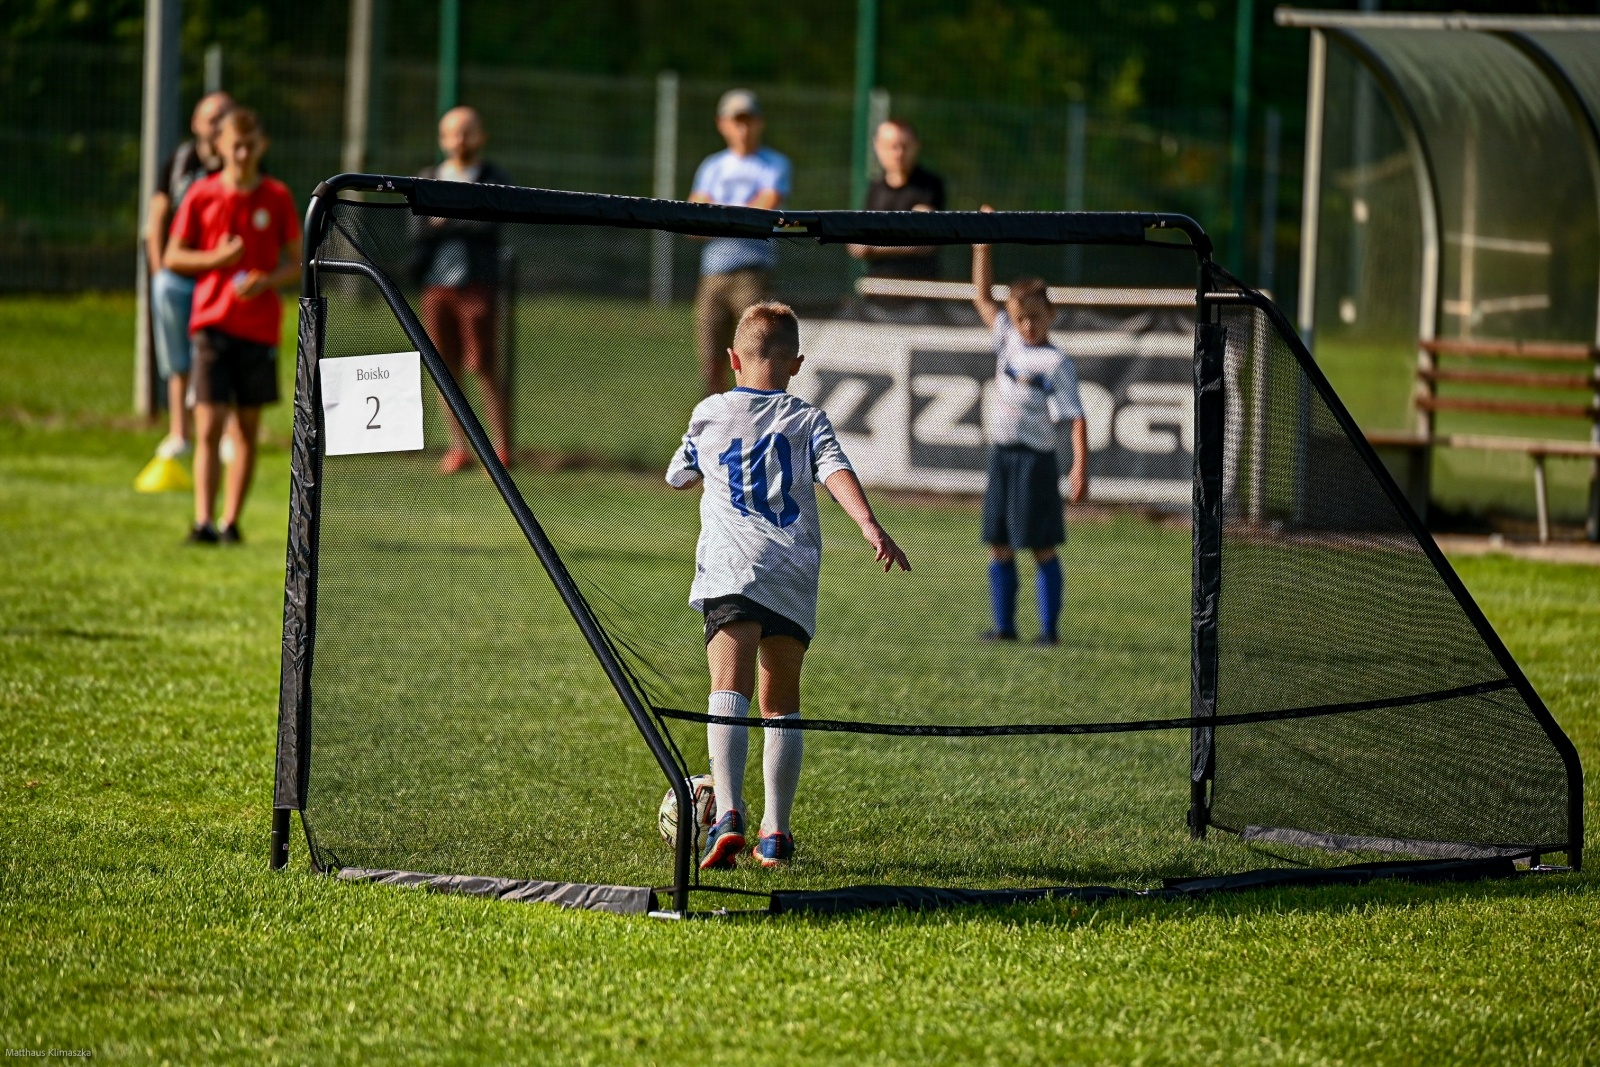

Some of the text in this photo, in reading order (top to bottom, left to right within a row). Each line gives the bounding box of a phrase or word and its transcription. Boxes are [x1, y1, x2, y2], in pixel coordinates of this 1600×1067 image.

[356, 367, 390, 381] Boisko
[366, 396, 381, 430] 2
[718, 432, 801, 529] 10
